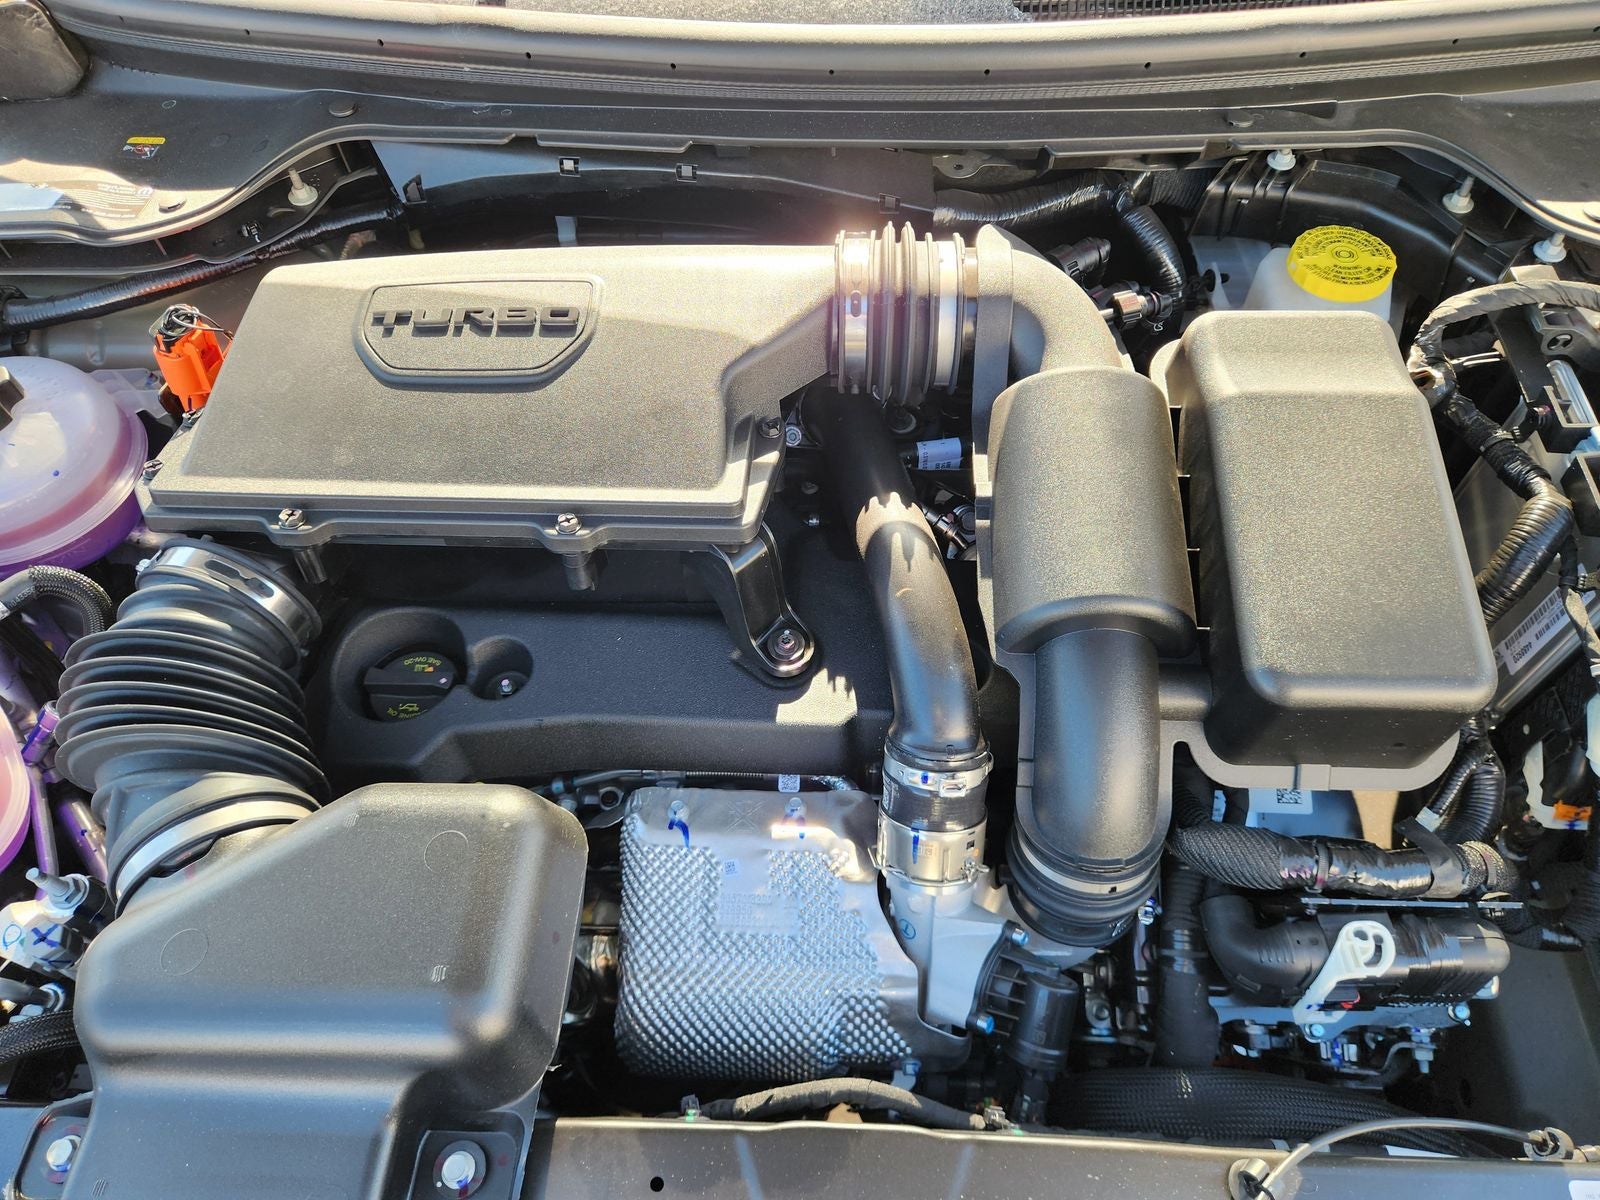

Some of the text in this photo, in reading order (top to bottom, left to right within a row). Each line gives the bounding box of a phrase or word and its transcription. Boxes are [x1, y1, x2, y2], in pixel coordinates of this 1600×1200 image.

[371, 306, 580, 335] TURBO
[426, 656, 442, 667] SAE
[387, 706, 398, 717] OIL
